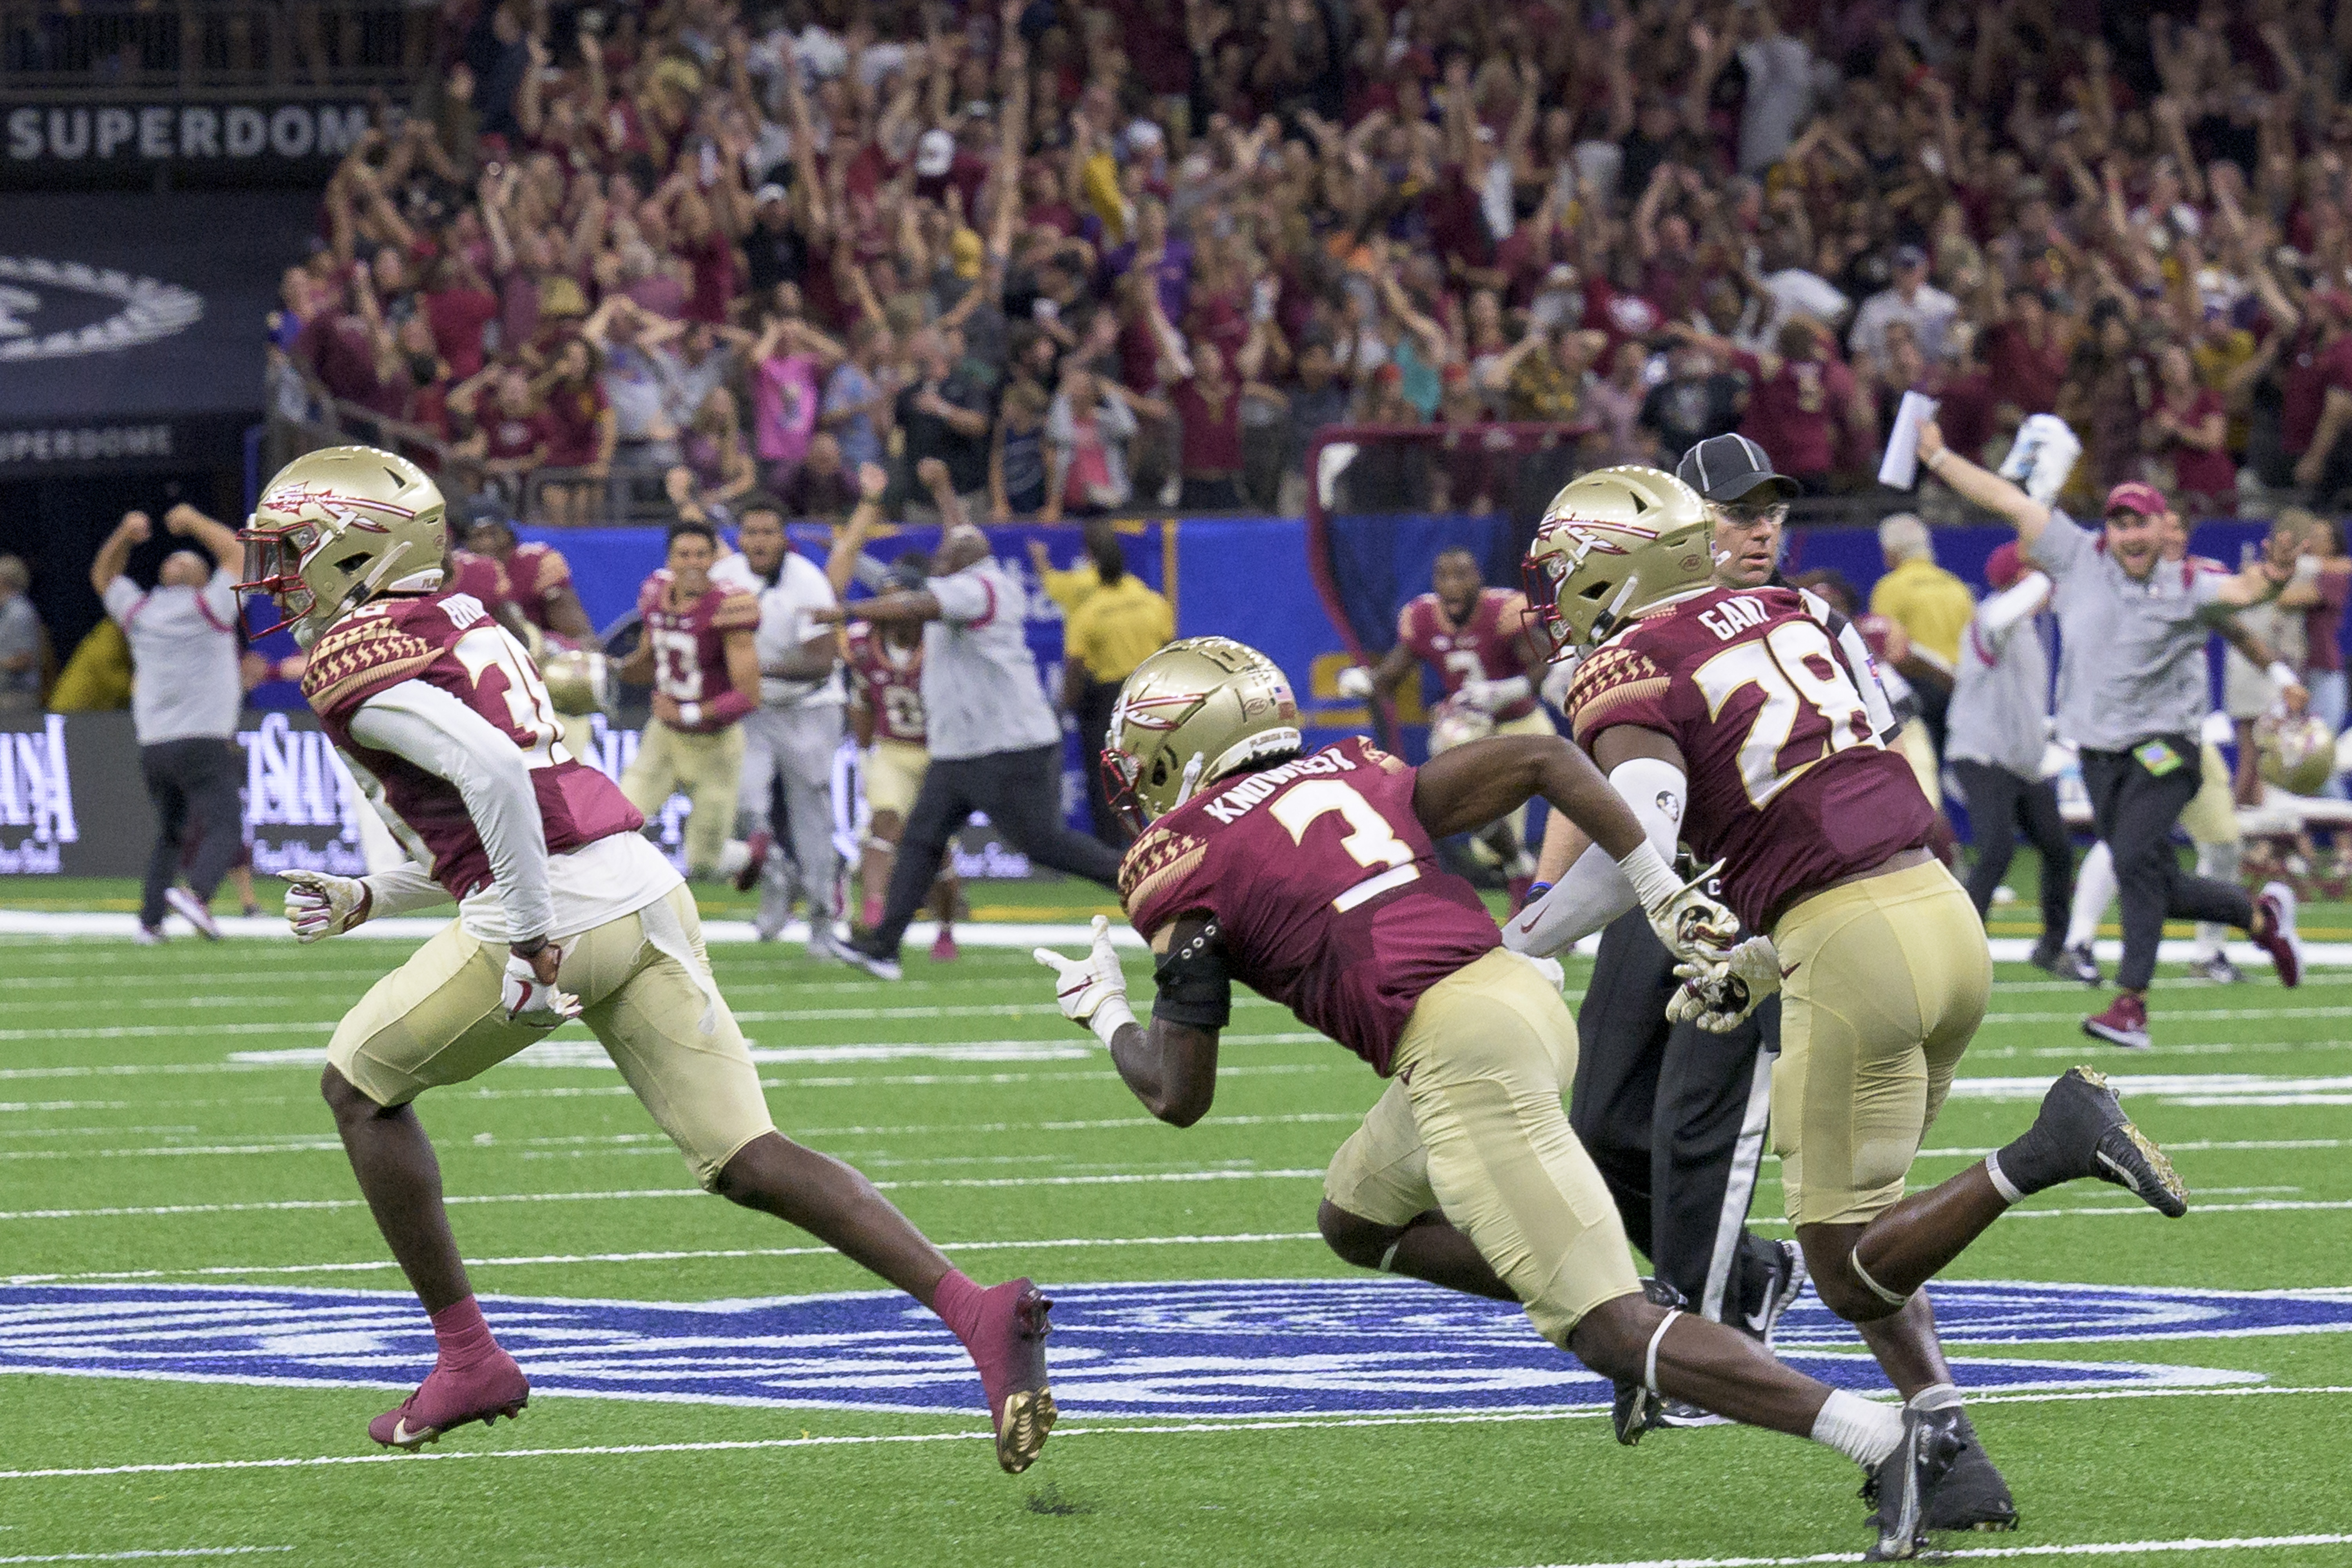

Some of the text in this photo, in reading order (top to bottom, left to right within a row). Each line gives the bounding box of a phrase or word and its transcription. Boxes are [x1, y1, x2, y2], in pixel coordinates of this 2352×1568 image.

[1691, 621, 1886, 811] 28
[1269, 779, 1421, 913] 3
[0, 1301, 1606, 1402] llstate
